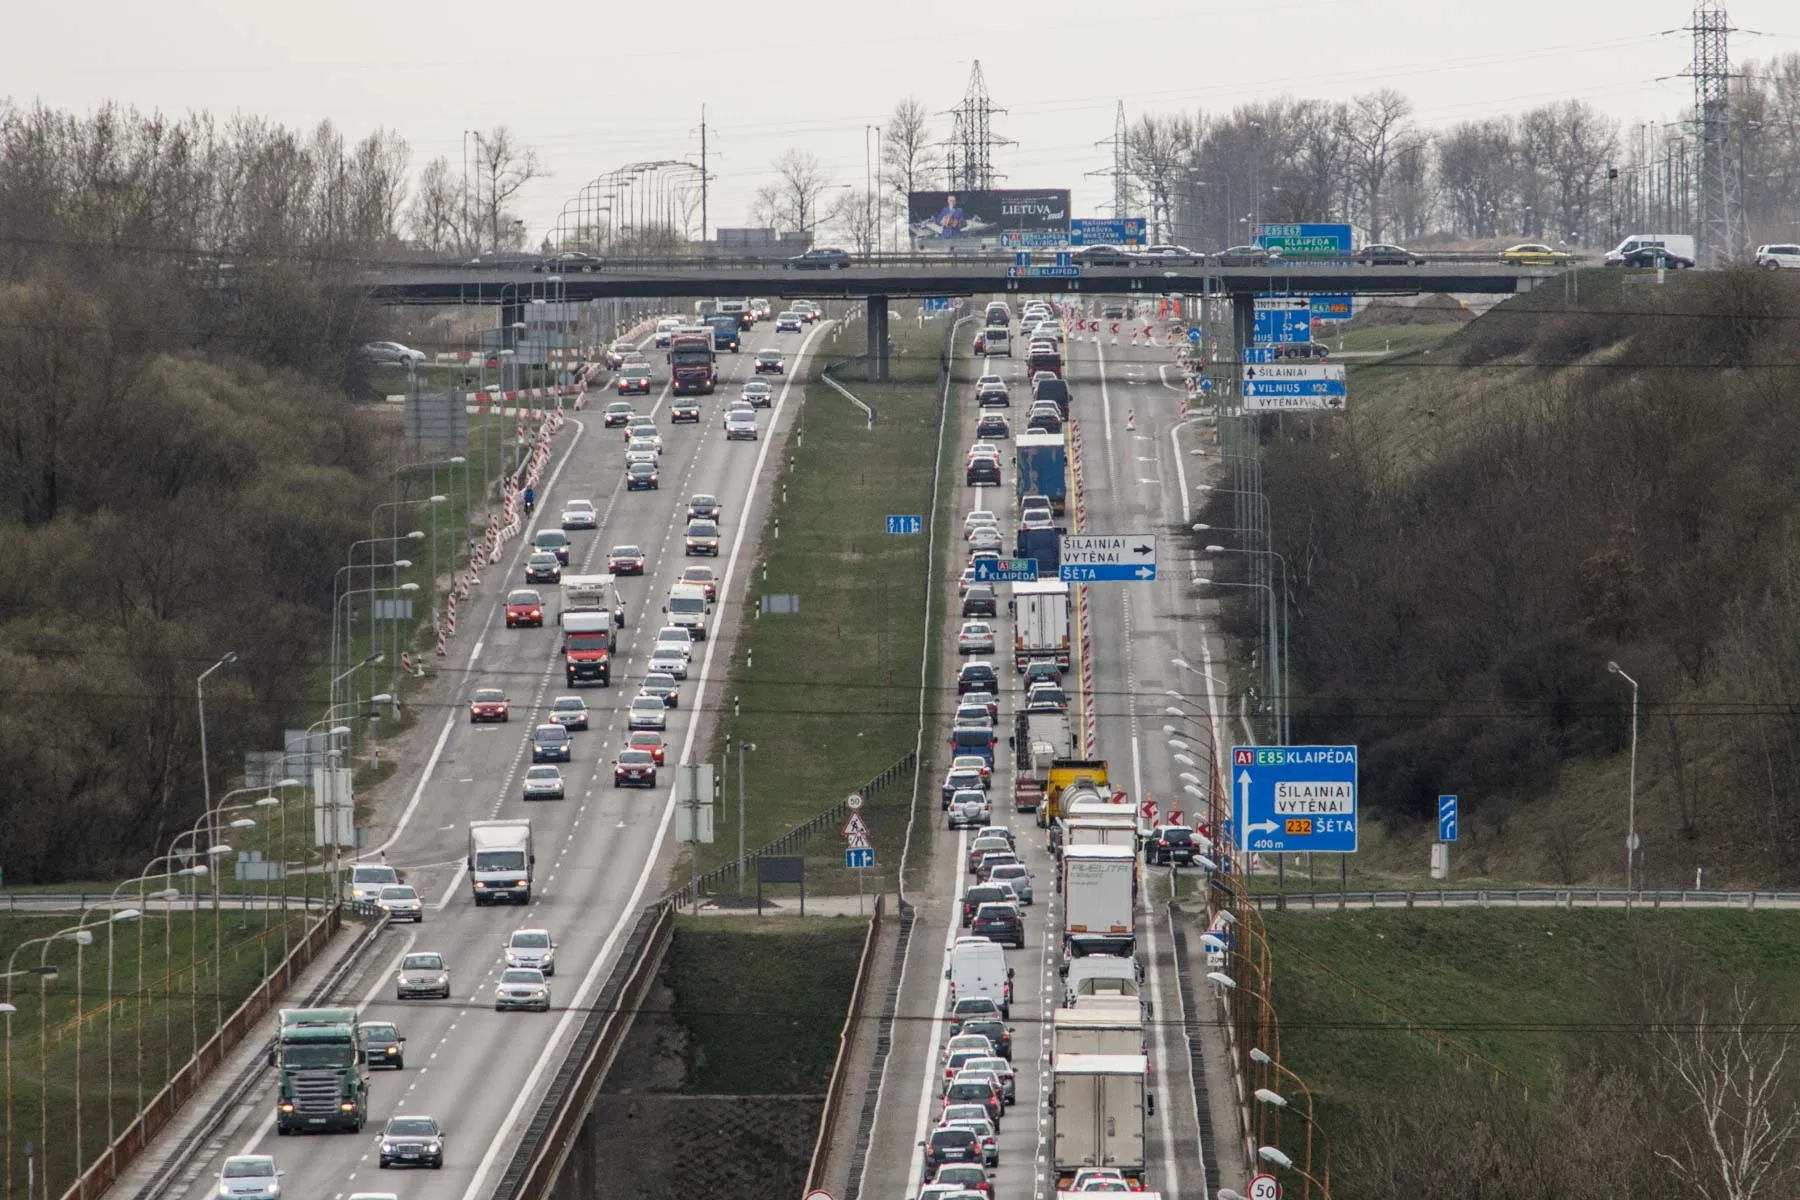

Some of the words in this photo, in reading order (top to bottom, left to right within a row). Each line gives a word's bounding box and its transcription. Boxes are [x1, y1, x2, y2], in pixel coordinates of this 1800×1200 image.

[1002, 204, 1050, 215] LIETUVA
[1259, 366, 1307, 377] ŠILAINIAI
[1258, 383, 1300, 393] VILNIUS
[1064, 536, 1126, 549] ŠILAINIAI
[1064, 551, 1119, 563] VYTĖNAI
[999, 561, 1009, 570] A1
[989, 571, 1036, 581] KLAIPĖDA
[1063, 567, 1096, 580] ŠĖTA
[1238, 752, 1252, 764] A1
[1258, 752, 1284, 764] E85
[1287, 749, 1354, 764] KLAIPĖDA
[1279, 783, 1350, 798] ŠILAINIAI
[1279, 799, 1343, 813] VYTĖNAI
[1287, 820, 1311, 832] 232
[1316, 818, 1354, 833] ŠĖTA
[1254, 840, 1273, 849] 400
[1275, 841, 1284, 849] m
[1256, 1184, 1275, 1199] 50
